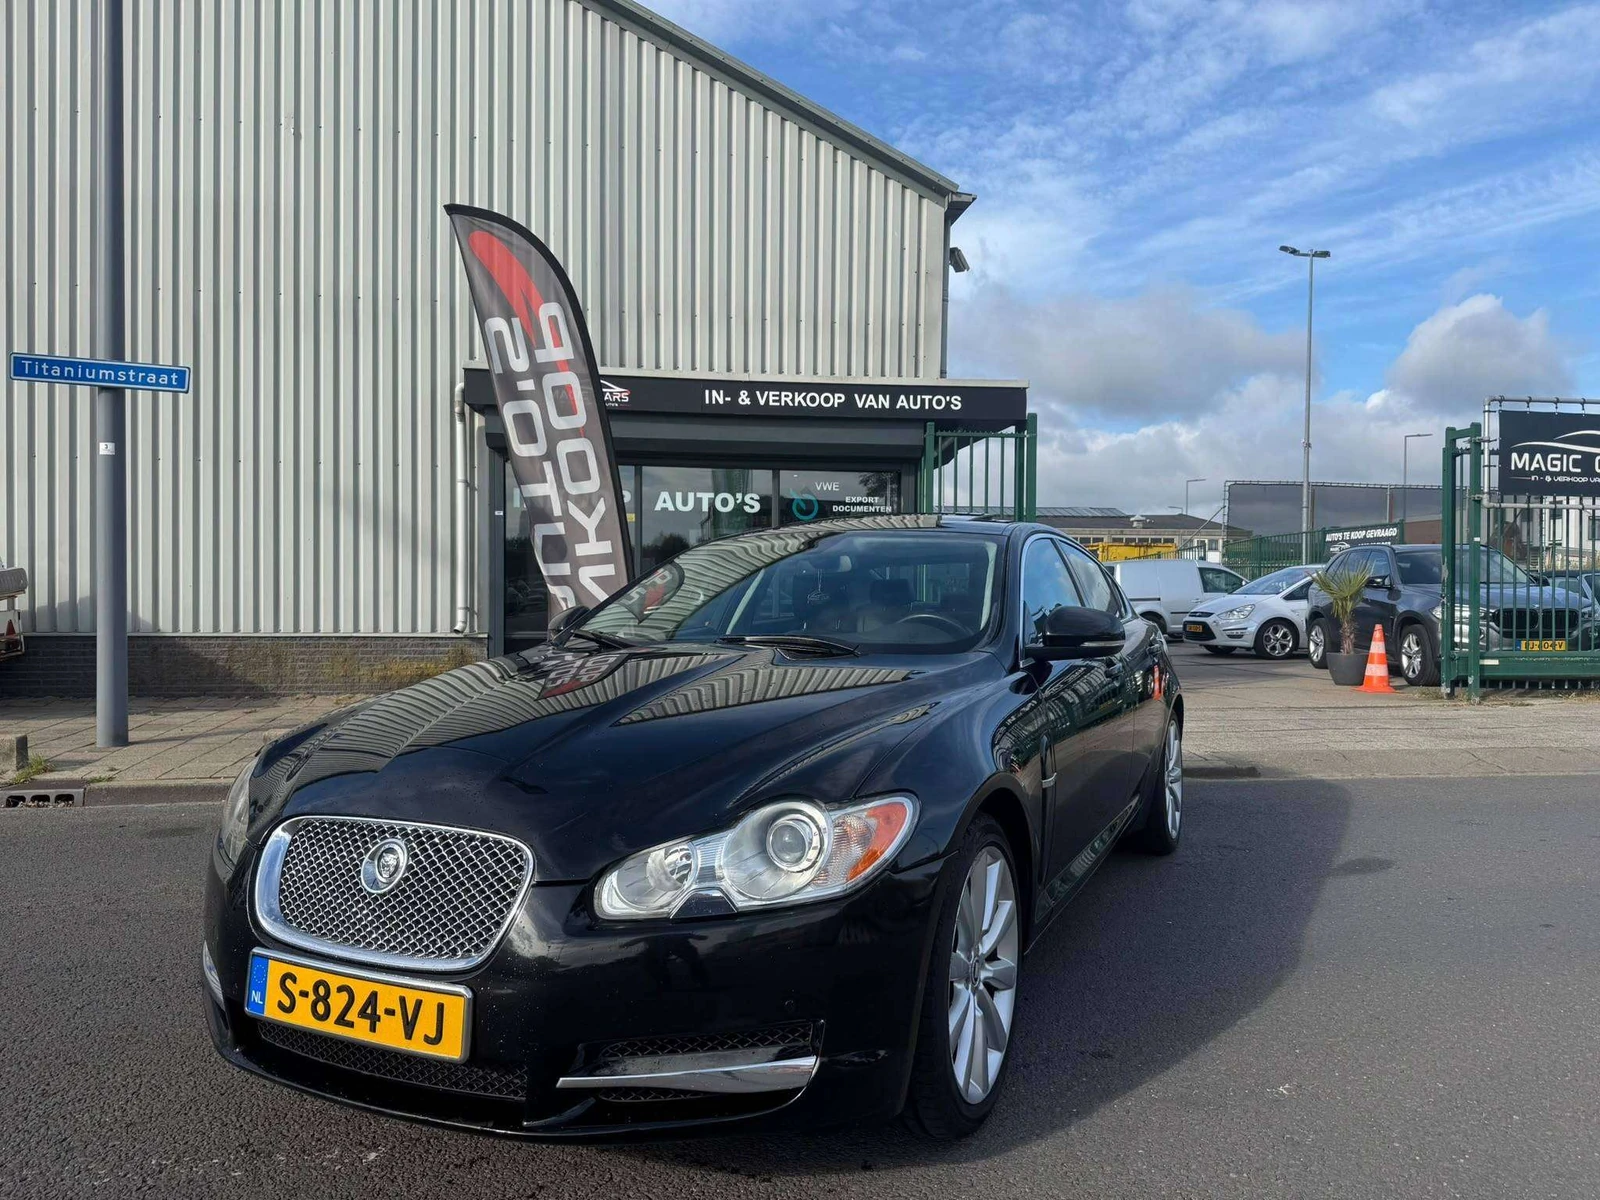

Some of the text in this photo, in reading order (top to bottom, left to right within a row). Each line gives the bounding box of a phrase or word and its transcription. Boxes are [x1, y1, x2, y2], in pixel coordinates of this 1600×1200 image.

[21, 360, 178, 385] Titaniumstraat
[604, 392, 629, 402] ARS
[704, 389, 962, 411] IN- & VERKOOP VAN AUTO'S
[1511, 452, 1582, 473] MAGIC
[815, 482, 840, 491] VWE
[654, 491, 761, 514] AUTO'S
[832, 505, 892, 513] DOCUMENTEN
[1325, 527, 1398, 542] AUTO'S TE KOOP GEVRAAGD
[251, 990, 264, 1005] NL
[276, 971, 445, 1045] S-824-VJ
